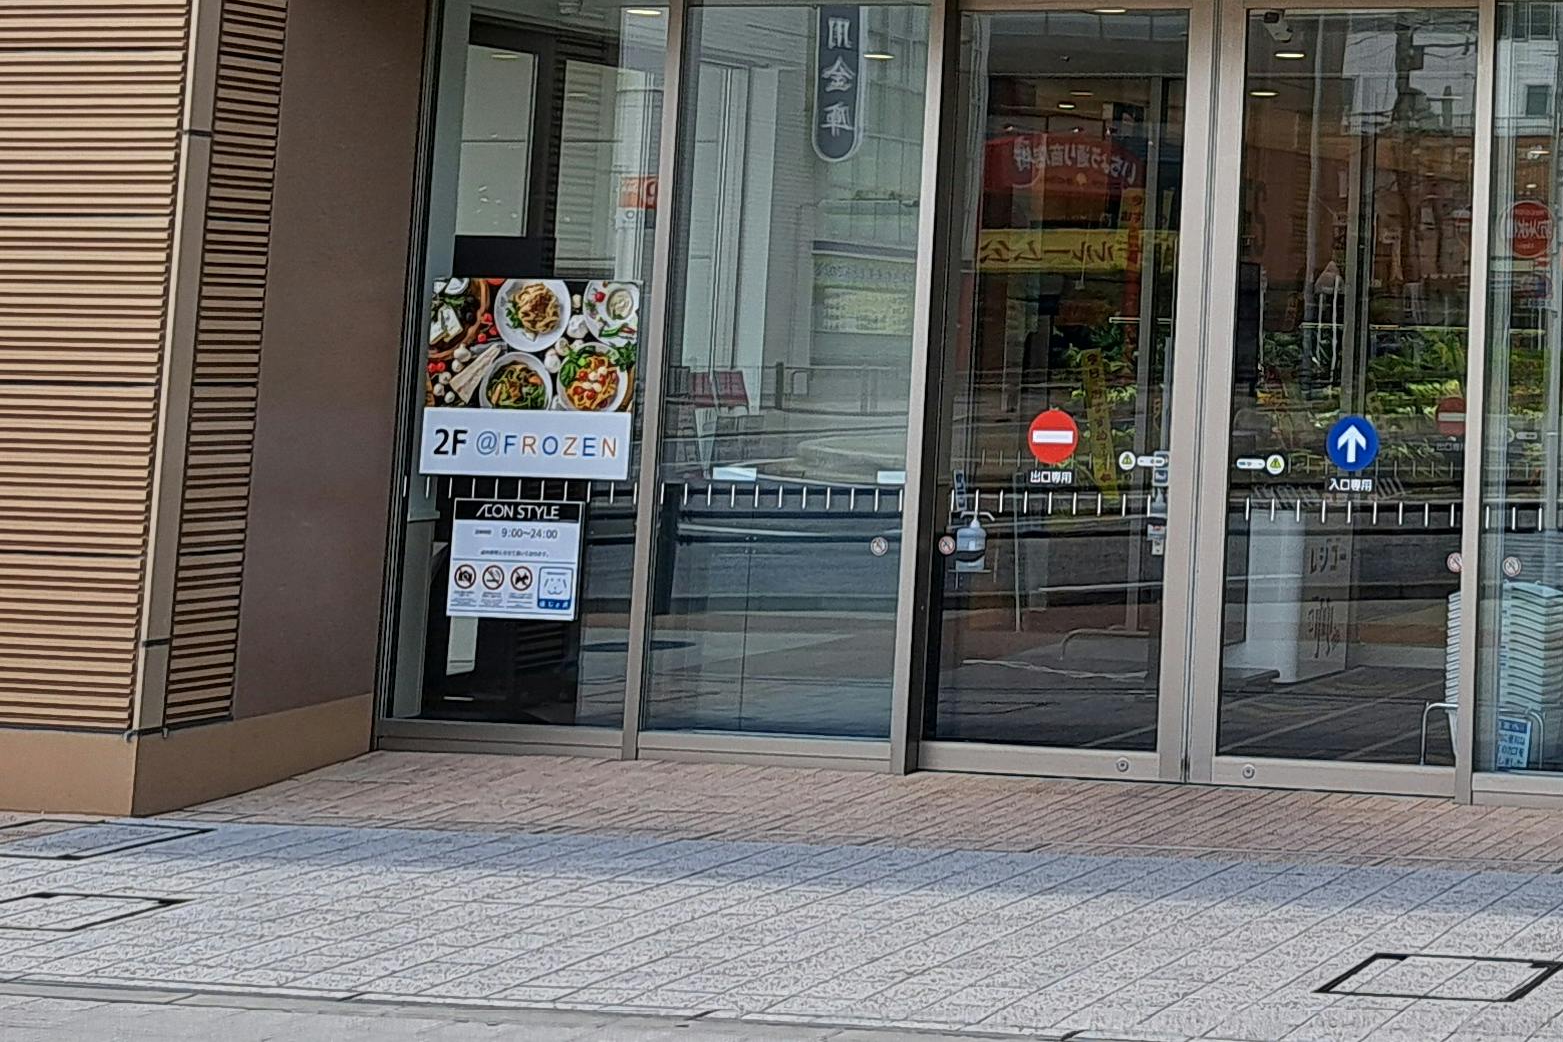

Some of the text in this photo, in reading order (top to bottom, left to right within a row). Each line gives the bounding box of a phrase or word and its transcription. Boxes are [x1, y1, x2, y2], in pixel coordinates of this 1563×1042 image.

[433, 428, 468, 456] 2F
[1030, 470, 1072, 484] 出口専用
[1328, 478, 1373, 491] 入口専用
[517, 505, 560, 519] STYLE
